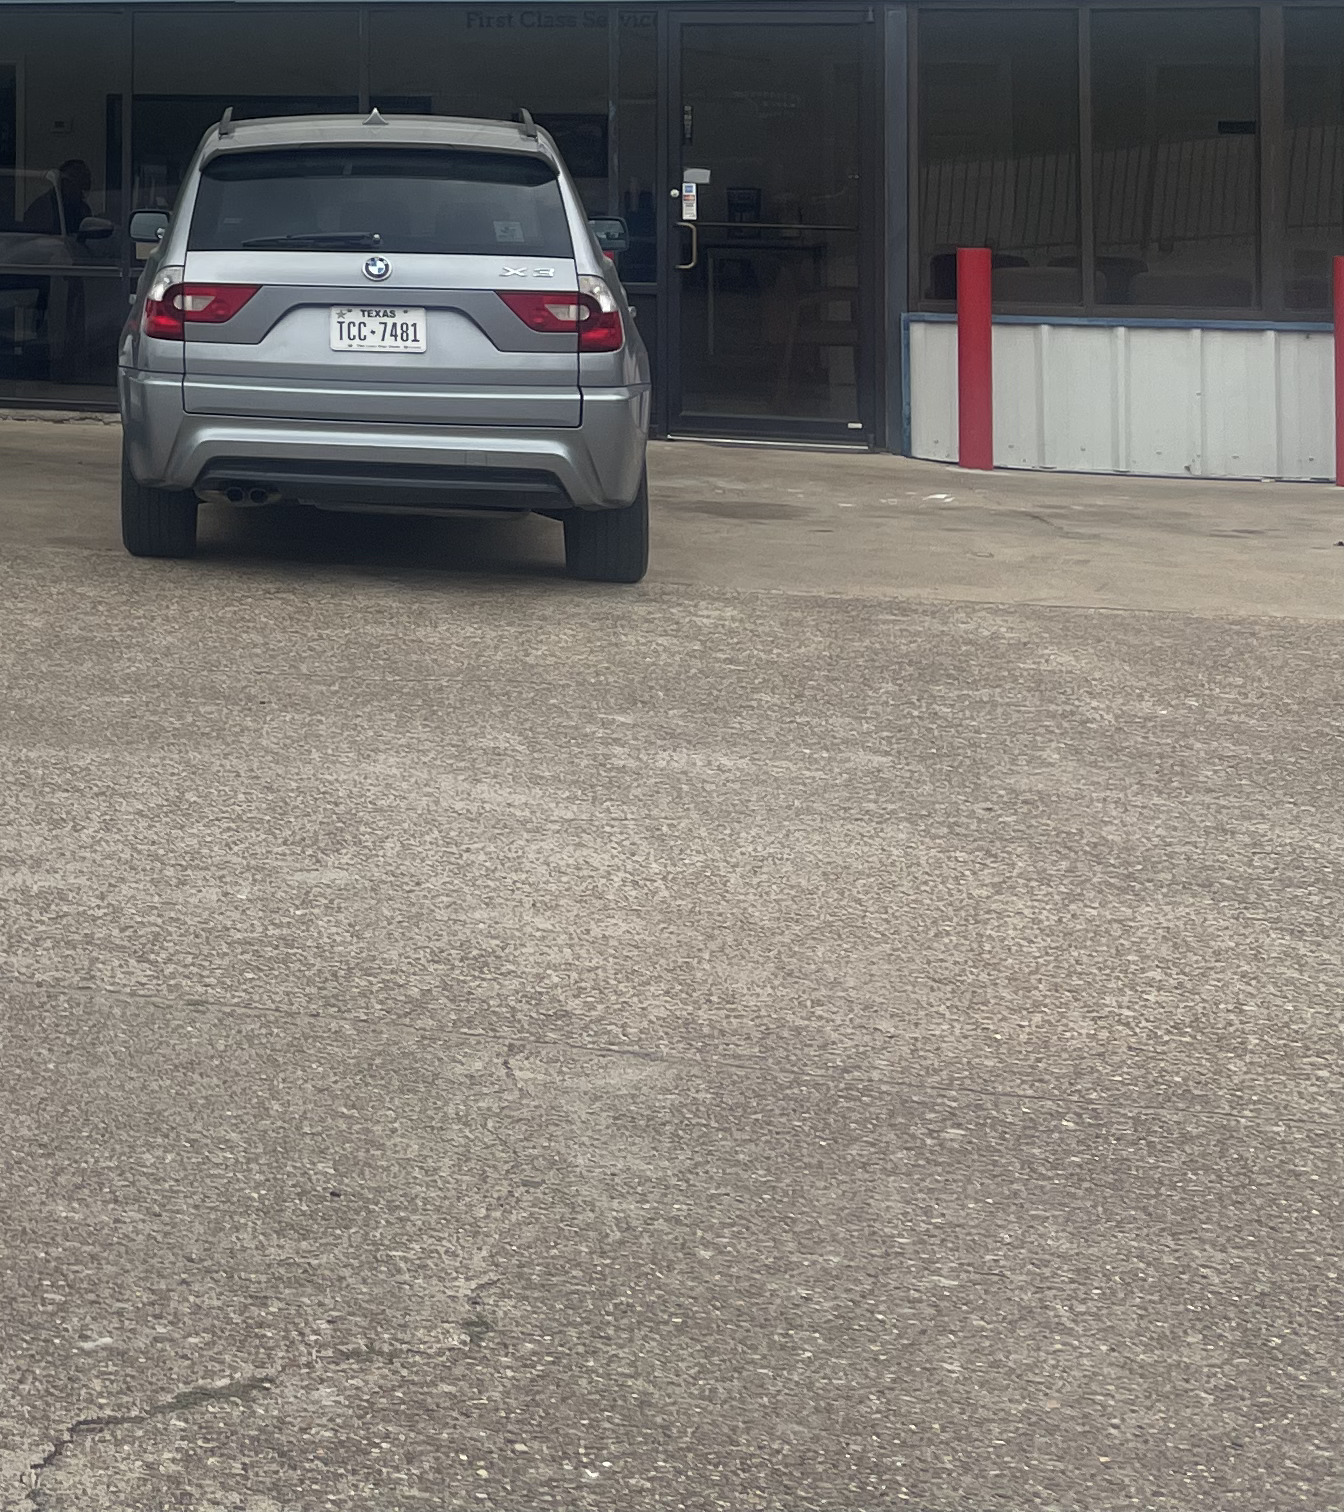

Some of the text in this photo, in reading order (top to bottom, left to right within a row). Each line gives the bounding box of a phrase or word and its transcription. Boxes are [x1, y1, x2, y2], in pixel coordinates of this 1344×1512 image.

[466, 11, 513, 29] First
[520, 11, 577, 28] Class
[499, 266, 555, 278] X3
[360, 309, 397, 318] TEXAS
